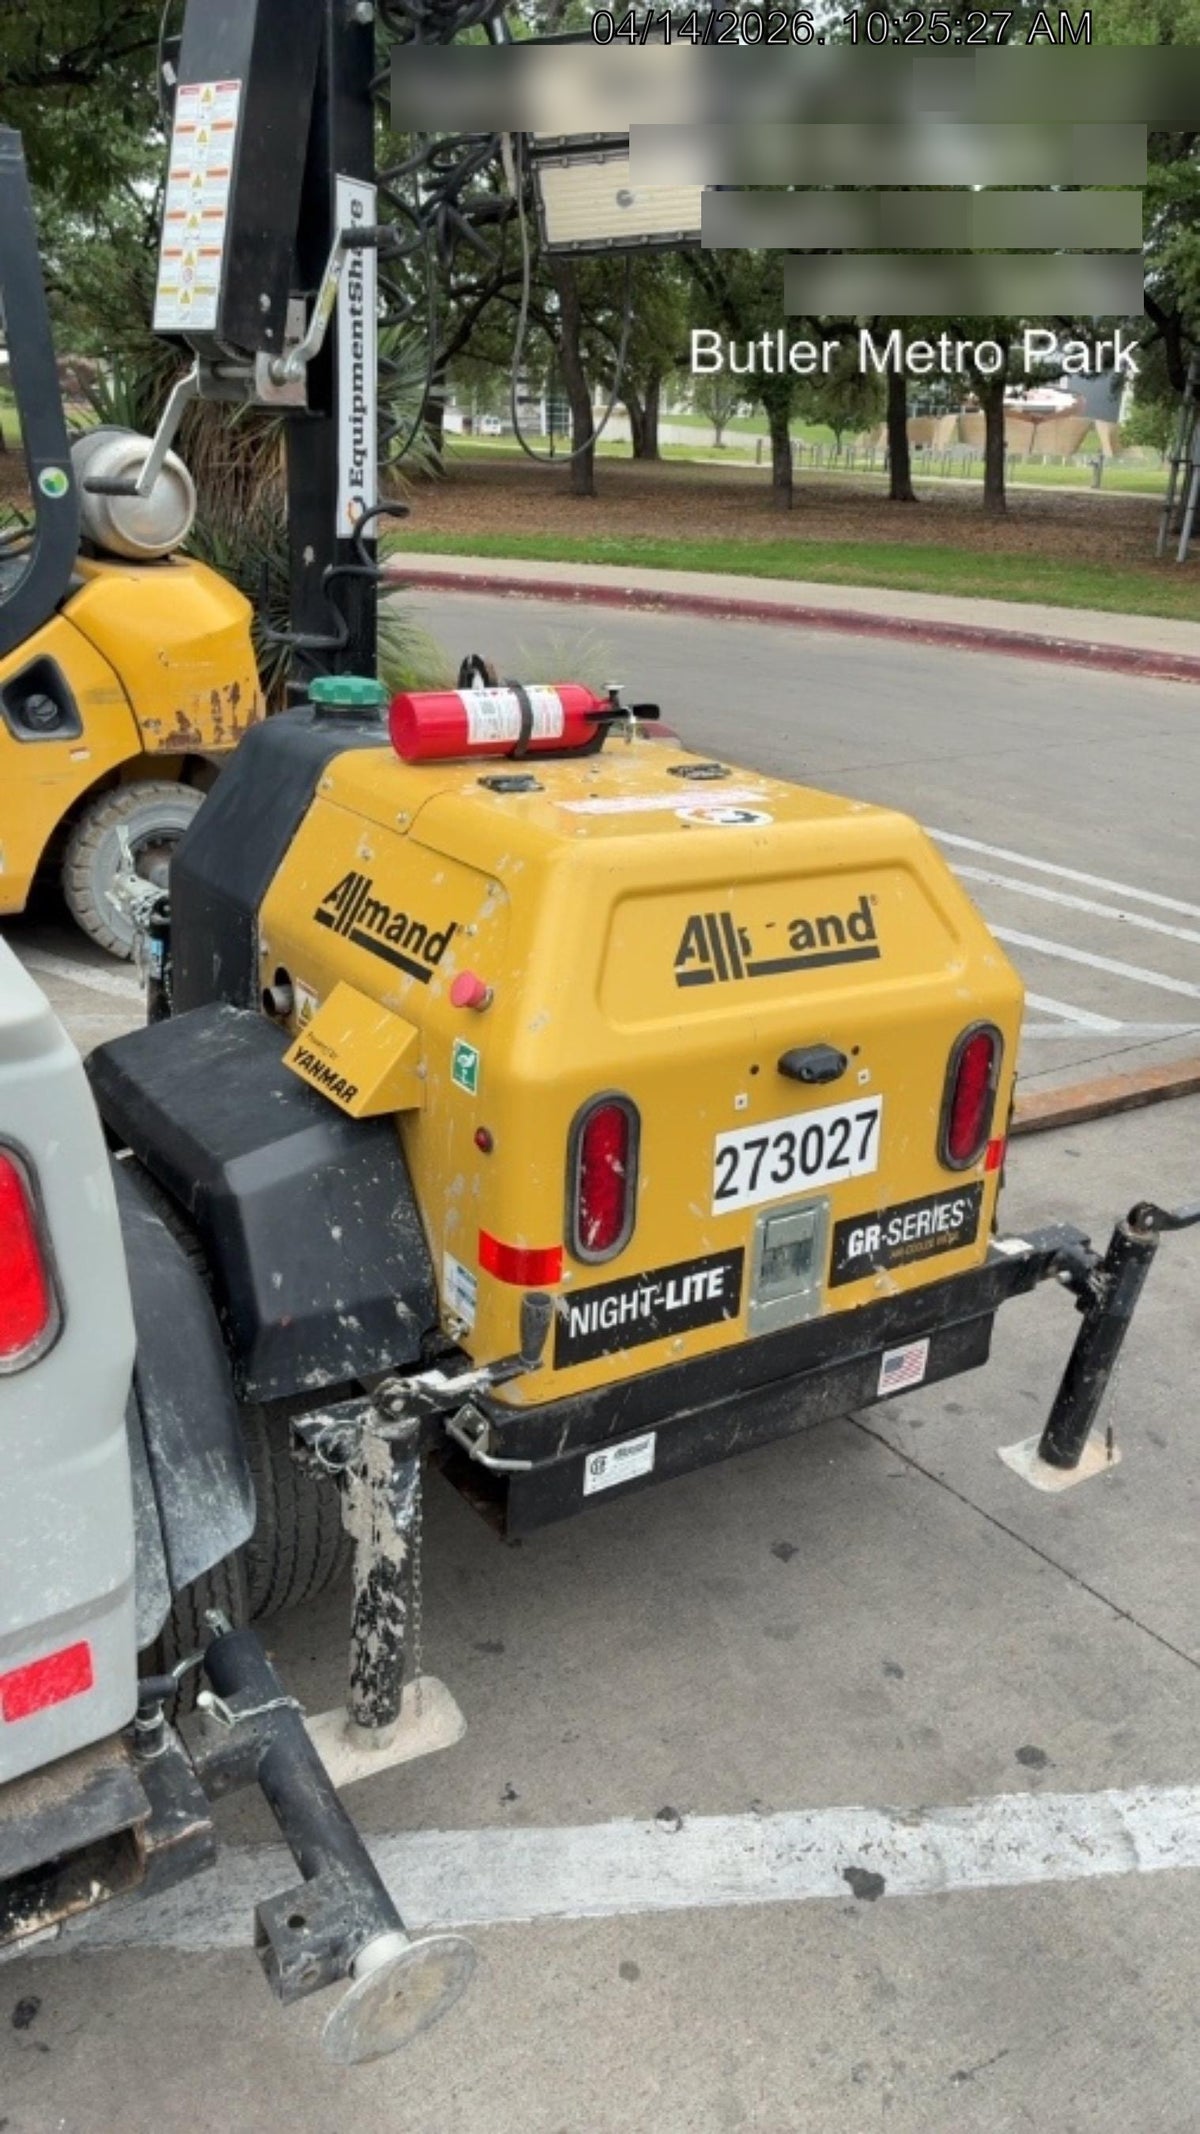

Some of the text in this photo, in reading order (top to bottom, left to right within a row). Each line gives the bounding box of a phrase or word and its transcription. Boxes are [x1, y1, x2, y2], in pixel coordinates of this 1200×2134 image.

[348, 198, 367, 489] EquipmentShe
[320, 870, 459, 967] Allmand
[674, 894, 879, 982] Alland
[293, 1045, 359, 1104] YANMAR
[714, 1108, 879, 1200] 273027
[848, 1199, 966, 1259] GR-SERIES
[568, 1265, 726, 1339] NIGHT-LITE
